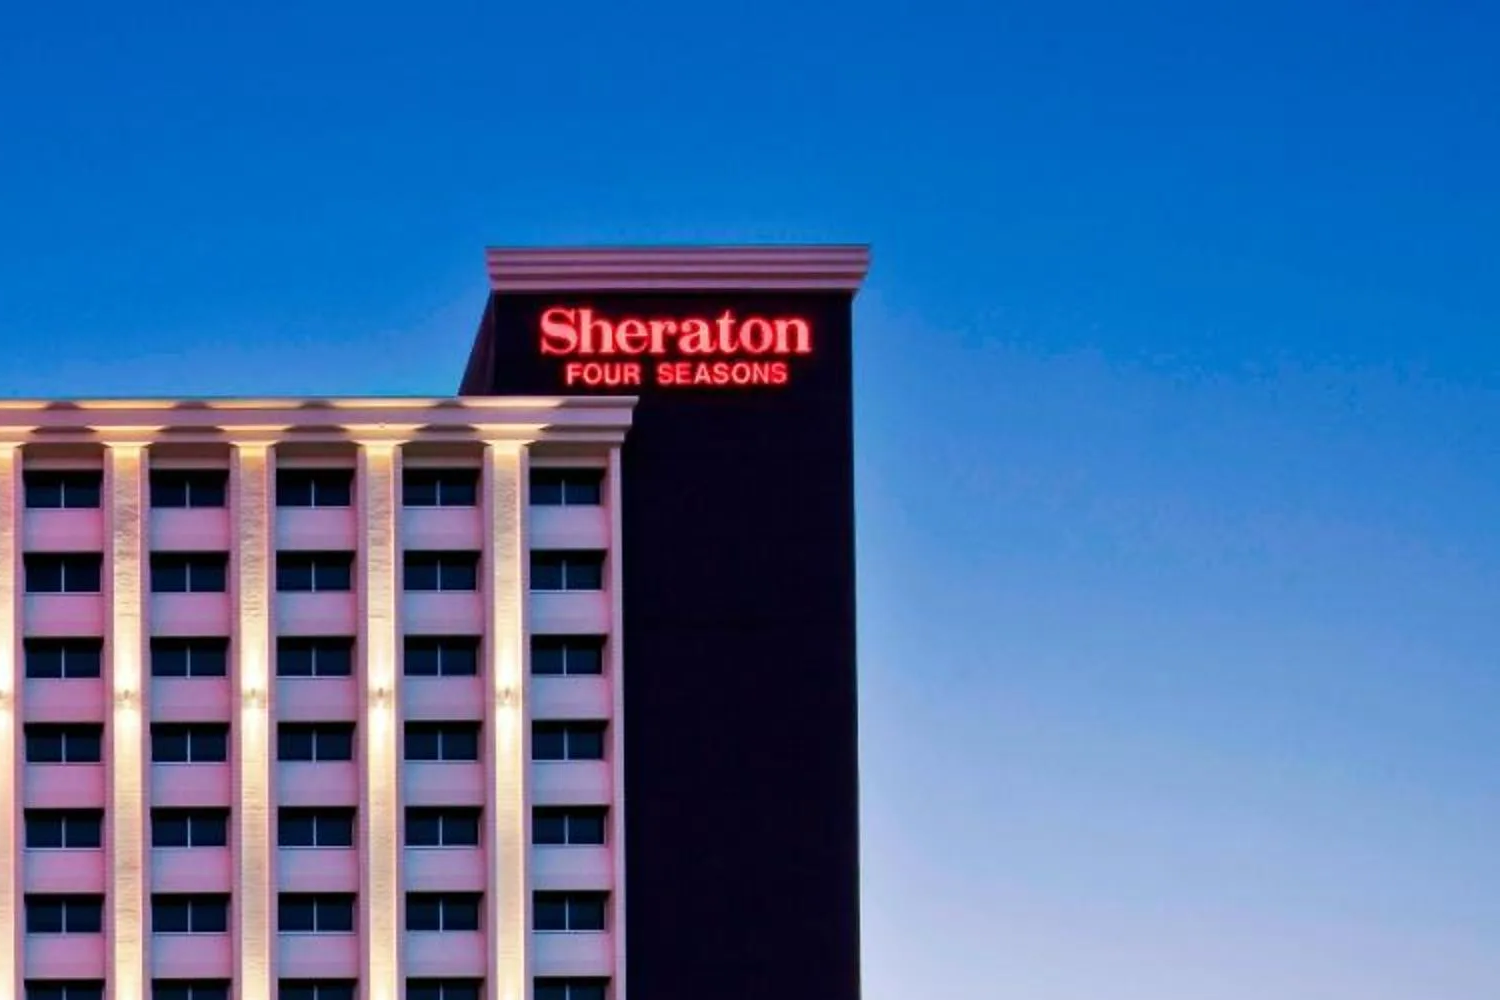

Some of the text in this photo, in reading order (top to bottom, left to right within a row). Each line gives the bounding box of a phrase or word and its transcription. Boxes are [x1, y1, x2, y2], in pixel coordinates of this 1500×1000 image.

[539, 307, 813, 355] Sheraton
[565, 362, 789, 386] FOUR SEASONS
